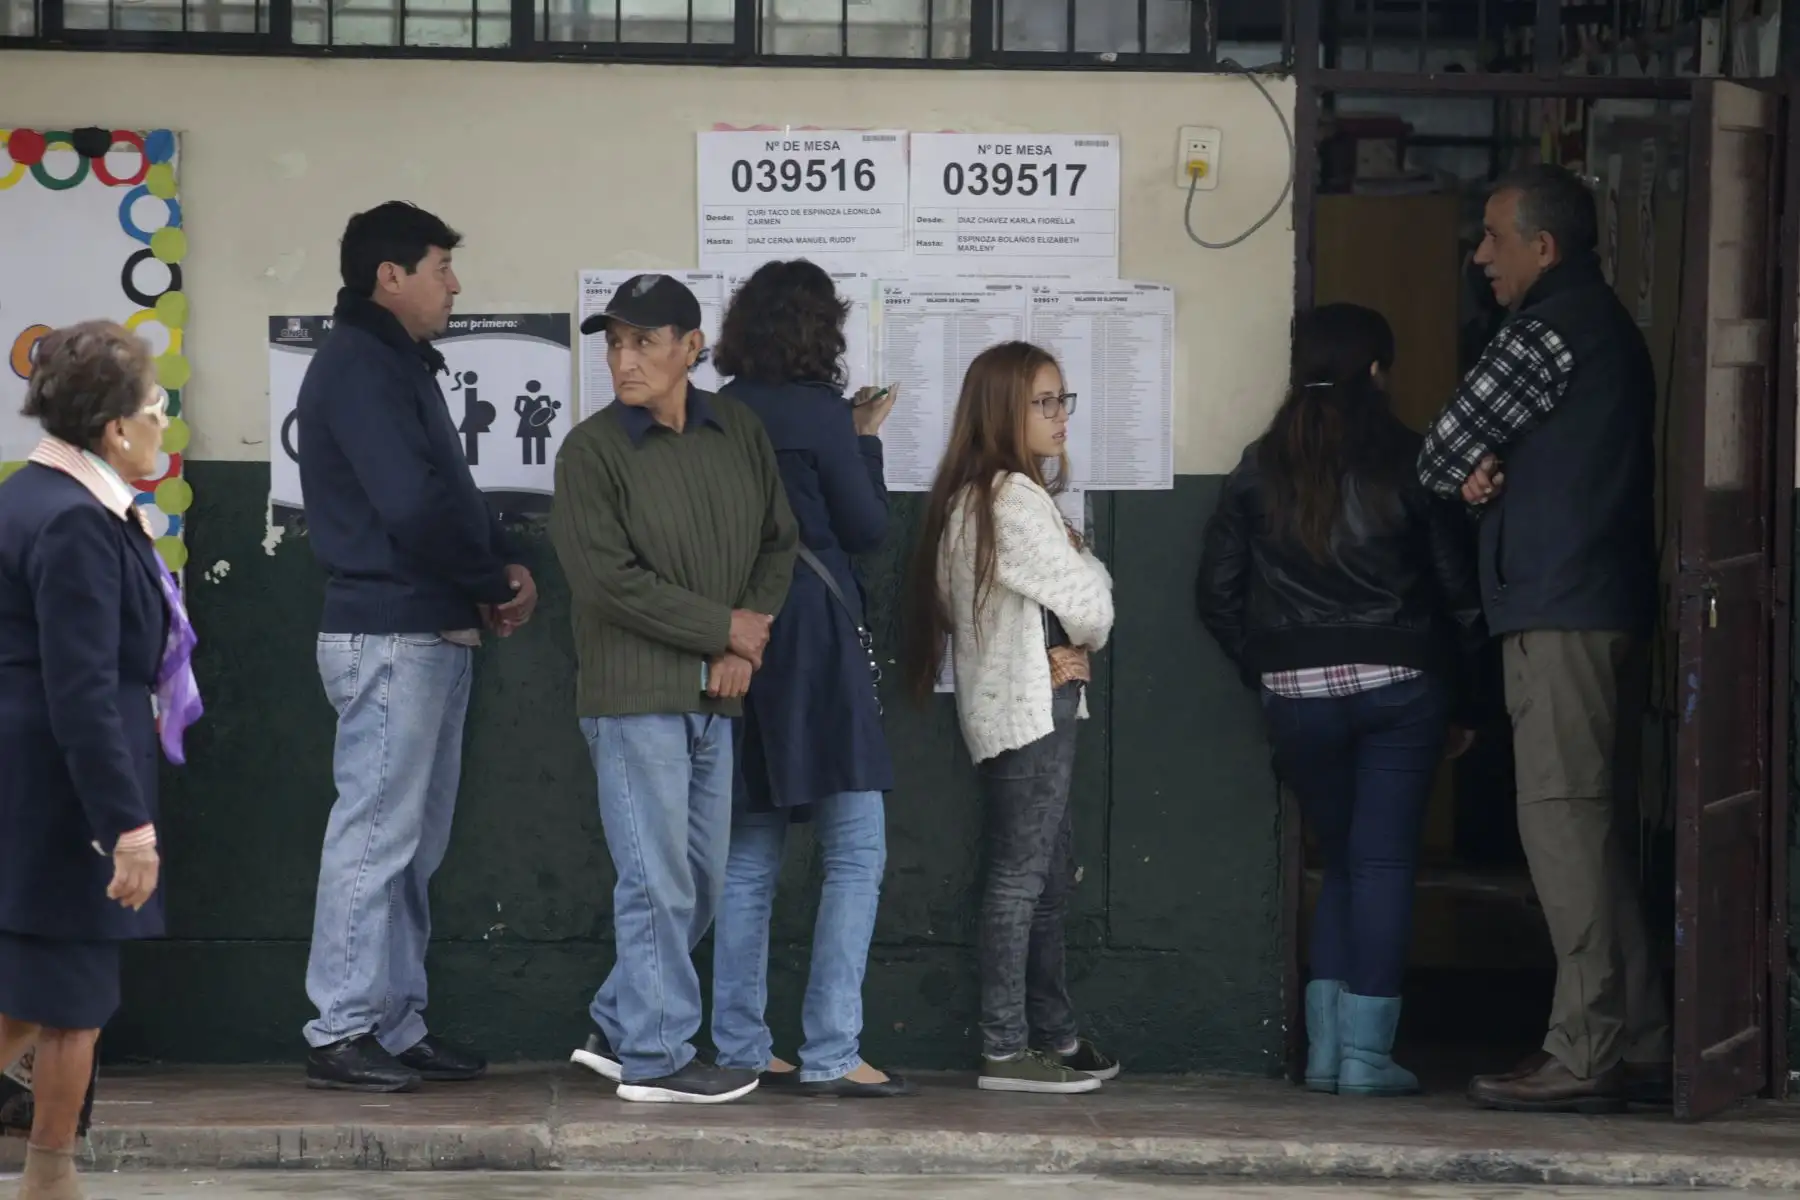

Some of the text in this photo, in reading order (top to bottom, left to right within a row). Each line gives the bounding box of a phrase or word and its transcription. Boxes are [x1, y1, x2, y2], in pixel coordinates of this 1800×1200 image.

[783, 141, 800, 152] DE
[804, 140, 840, 152] MESA
[995, 145, 1012, 155] DE
[1016, 145, 1053, 156] MESA
[731, 158, 876, 193] 039516
[943, 162, 1087, 196] 039517
[747, 207, 881, 216] CURI TACO DE ESPINOZA LEONILDA
[705, 214, 734, 222] Desde:
[916, 216, 944, 224] Desde:
[1009, 217, 1037, 225] KARLA
[1037, 217, 1075, 225] FIORELLA
[706, 238, 733, 246] Hasta:
[747, 237, 766, 245] DIAZ
[767, 237, 794, 245] CERNA
[957, 235, 997, 243] ESPINOZA
[1036, 236, 1080, 244] ELIZABETH
[916, 240, 943, 248] Hasta:
[957, 245, 995, 253] MARLENY
[448, 318, 519, 332] son primero:
